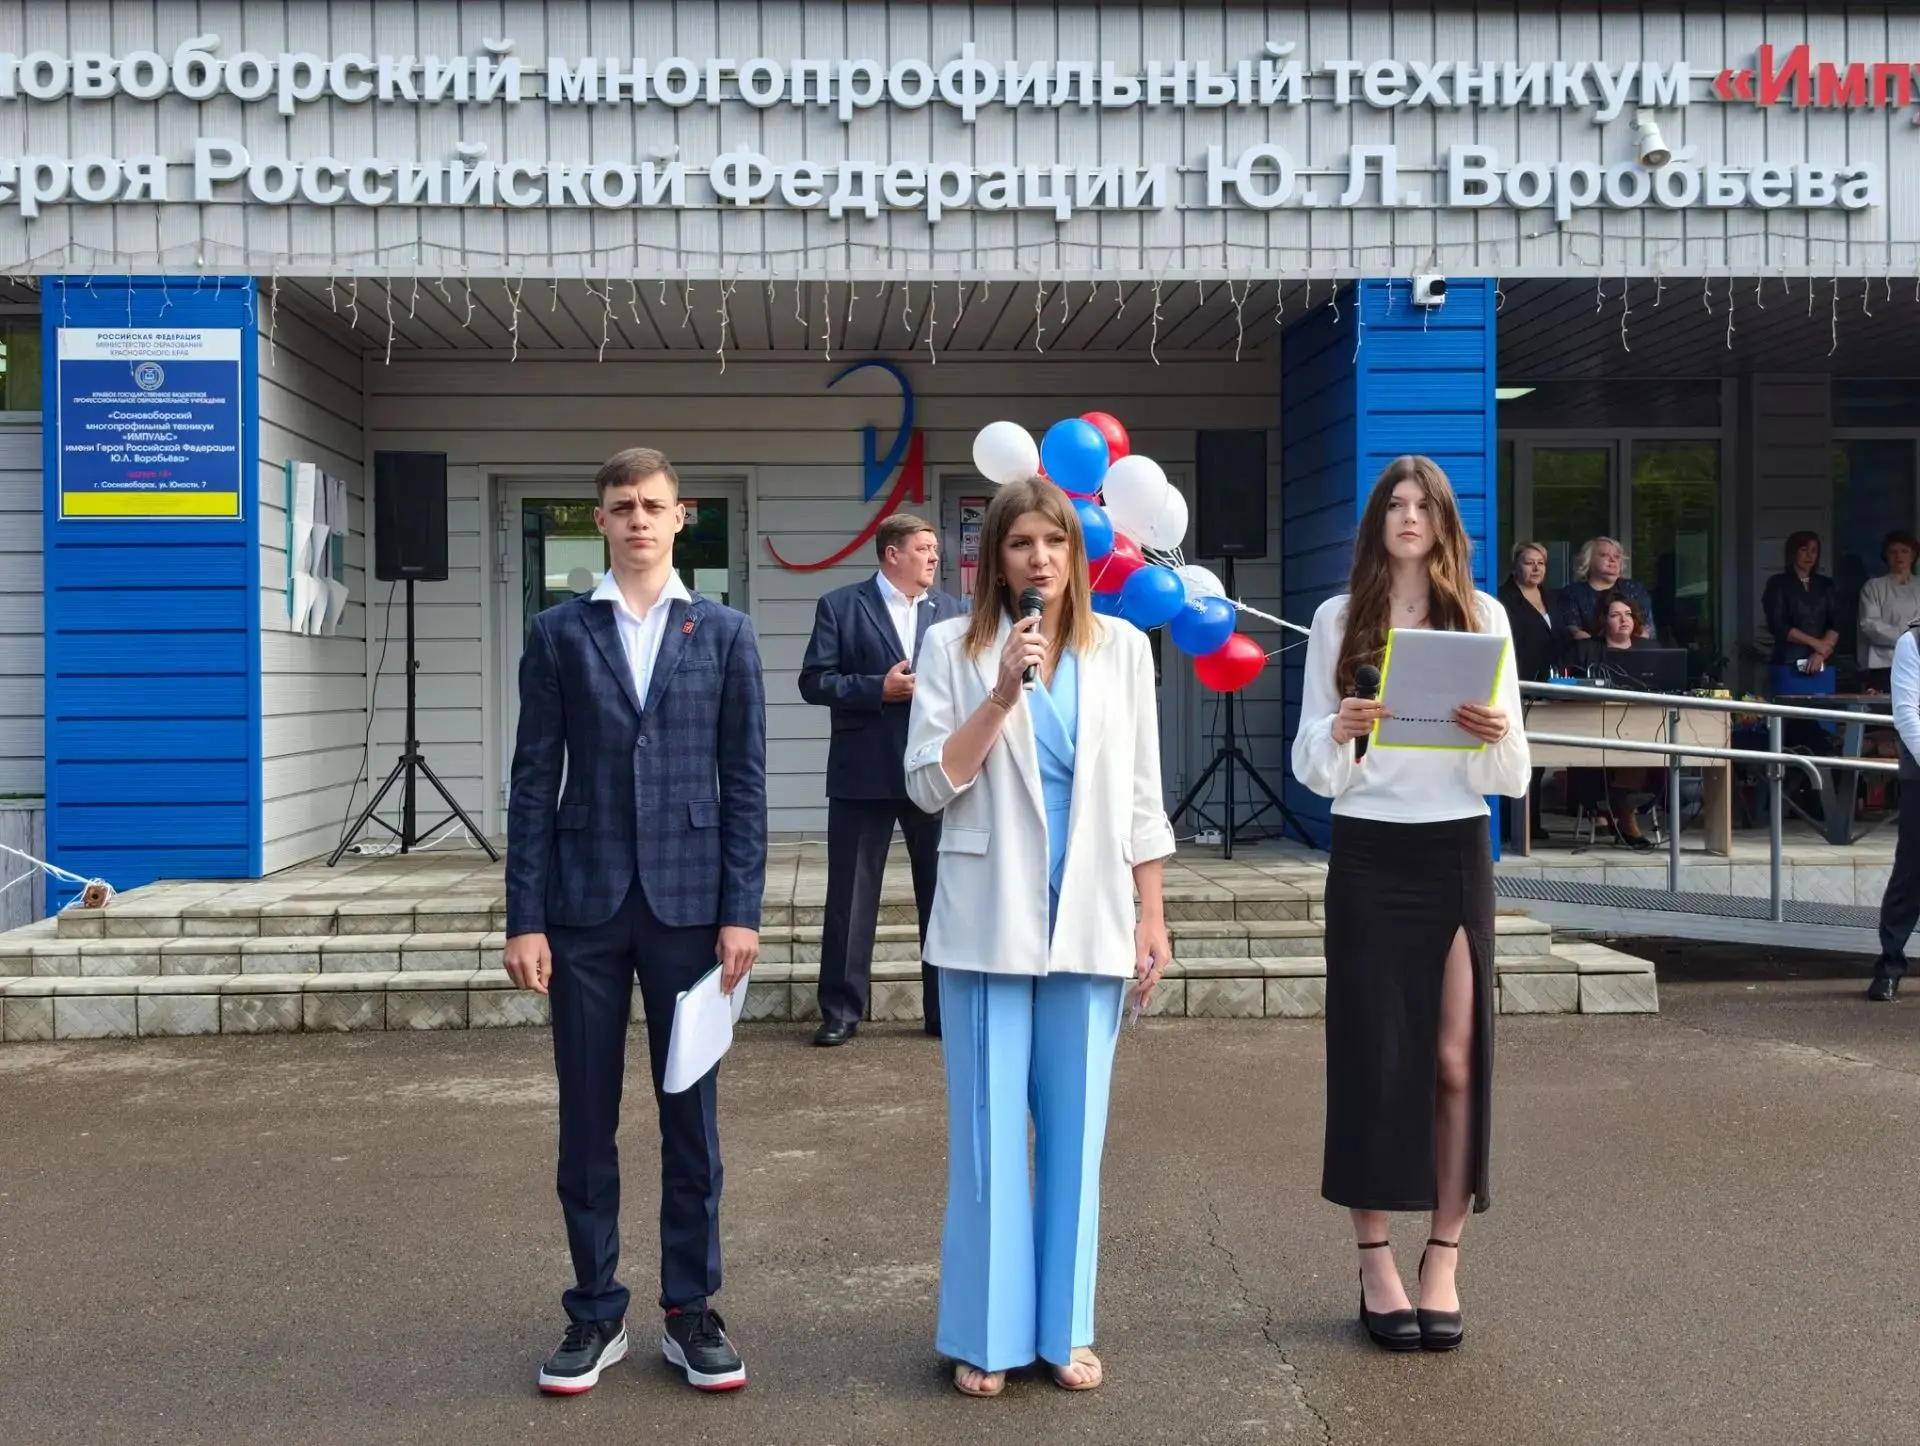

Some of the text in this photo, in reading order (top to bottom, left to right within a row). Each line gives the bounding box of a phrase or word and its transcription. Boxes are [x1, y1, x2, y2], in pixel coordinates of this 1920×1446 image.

[548, 41, 1300, 122] многопрофильный
[1324, 58, 1689, 121] техникум
[1711, 44, 1920, 126] «Имп
[194, 137, 685, 207] Российской
[709, 143, 1167, 222] Федерации
[1206, 143, 1317, 209] Ю.
[1340, 144, 1422, 207] Л.
[1448, 143, 1881, 221] Воробьева
[97, 333, 201, 342] РОССИЙСКАЯ ФЕДЕРАЦИЯ
[86, 421, 214, 432] многопрофильный техникум
[122, 432, 178, 442] «ИМПУЛЬС»
[97, 443, 124, 453] Героя
[126, 443, 180, 452] Российской
[183, 443, 235, 453] Федерации
